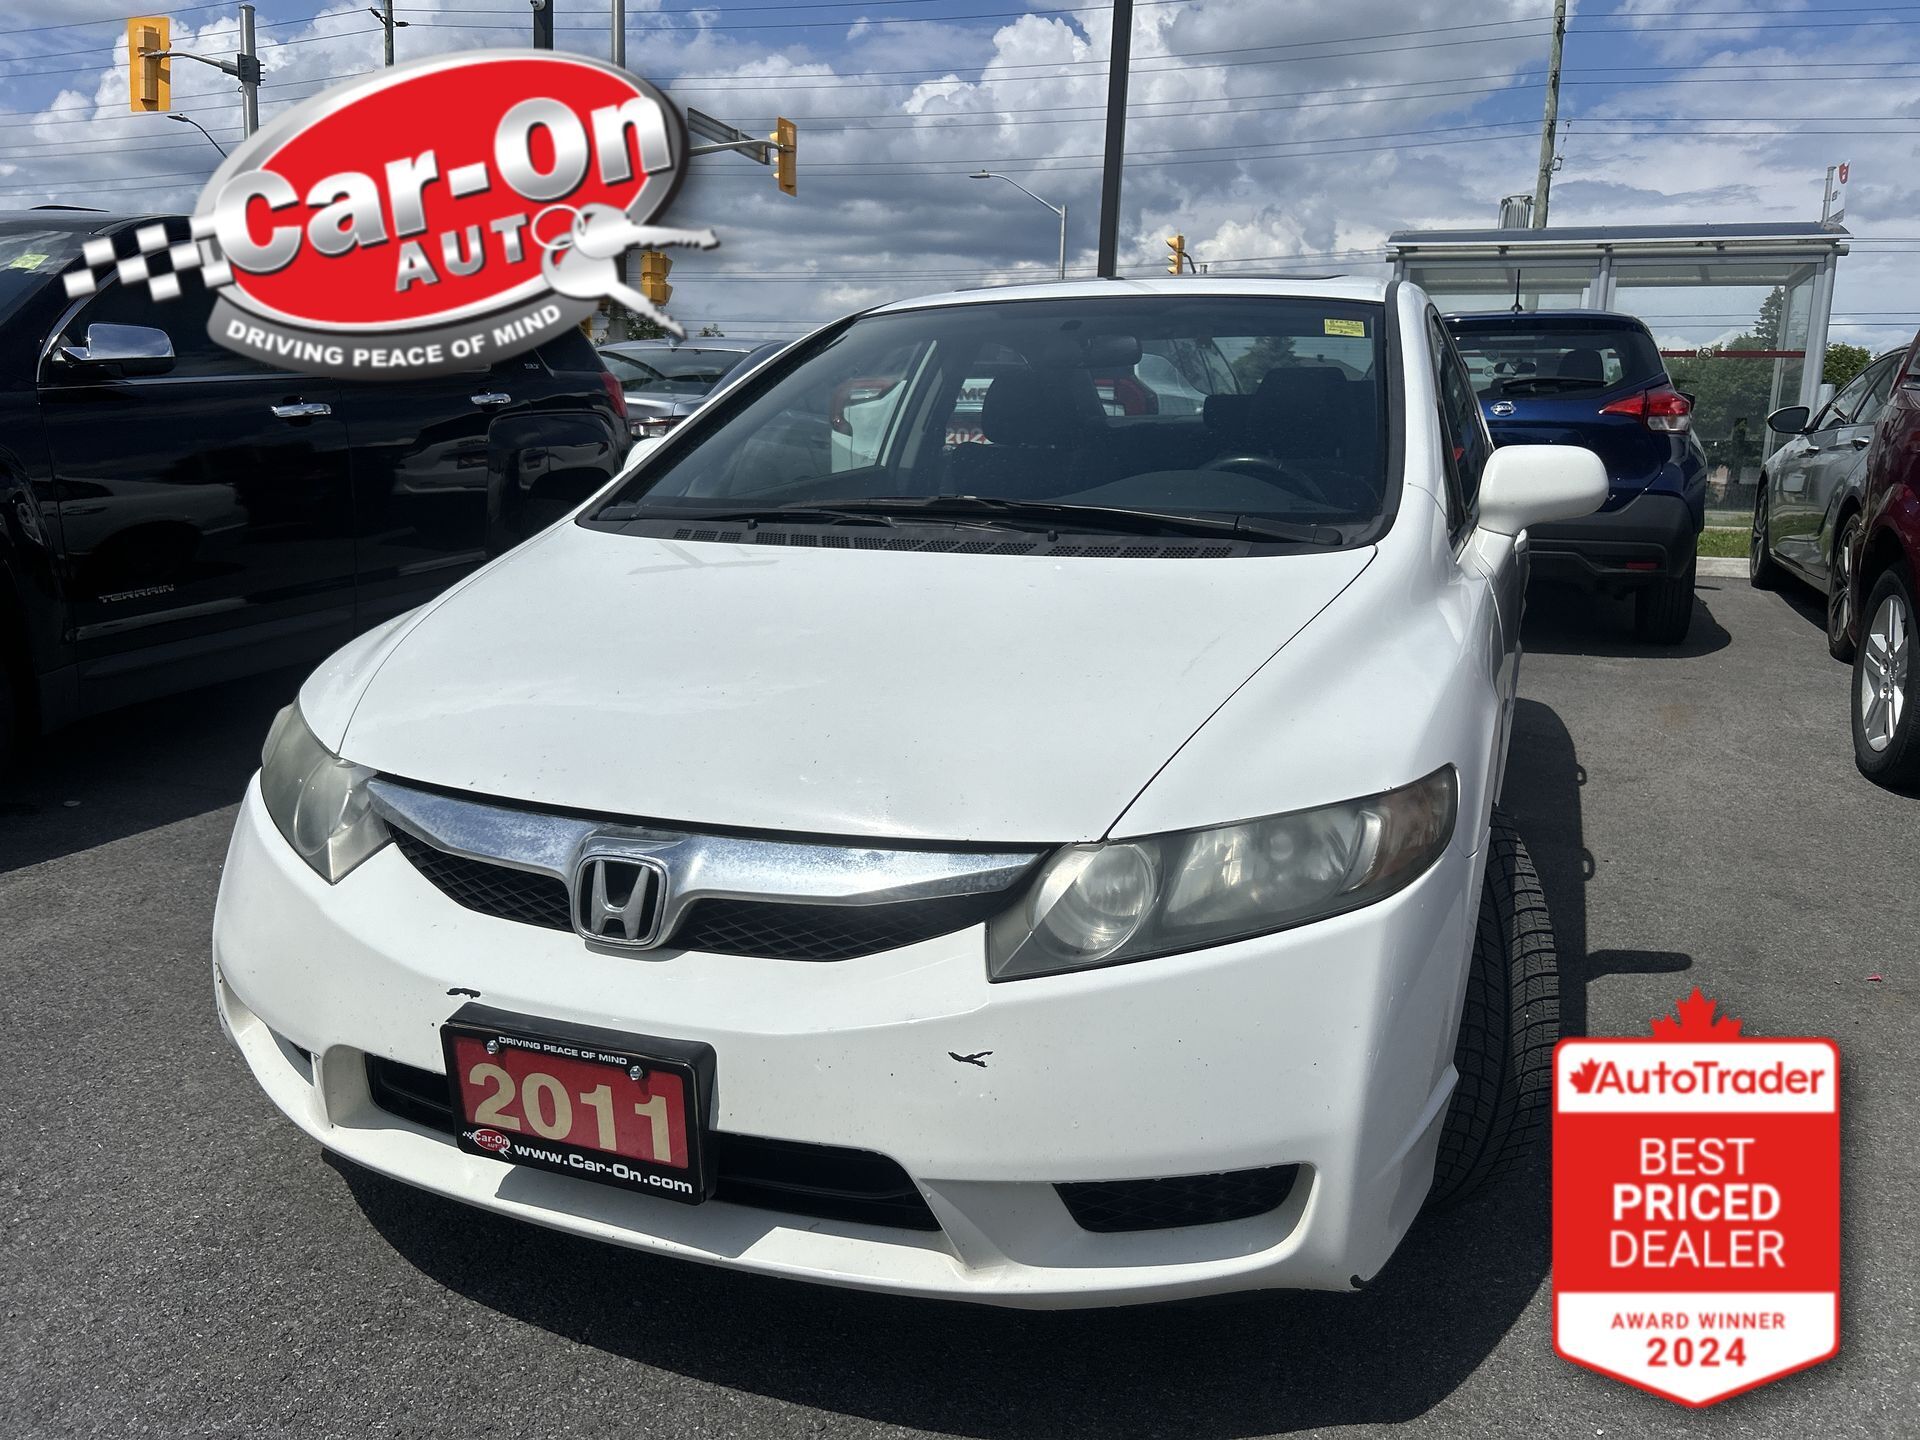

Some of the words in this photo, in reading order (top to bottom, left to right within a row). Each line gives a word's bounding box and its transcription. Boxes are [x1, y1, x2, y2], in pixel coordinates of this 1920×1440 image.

[98, 584, 175, 603] TERRAIN
[498, 1036, 541, 1049] DRIVING
[543, 1044, 578, 1057] PEACE
[581, 1050, 596, 1060] OF
[598, 1053, 628, 1065] MIND
[469, 1062, 672, 1163] 2011
[475, 1132, 510, 1146] Car-On
[514, 1144, 694, 1194] www.Car-On.com
